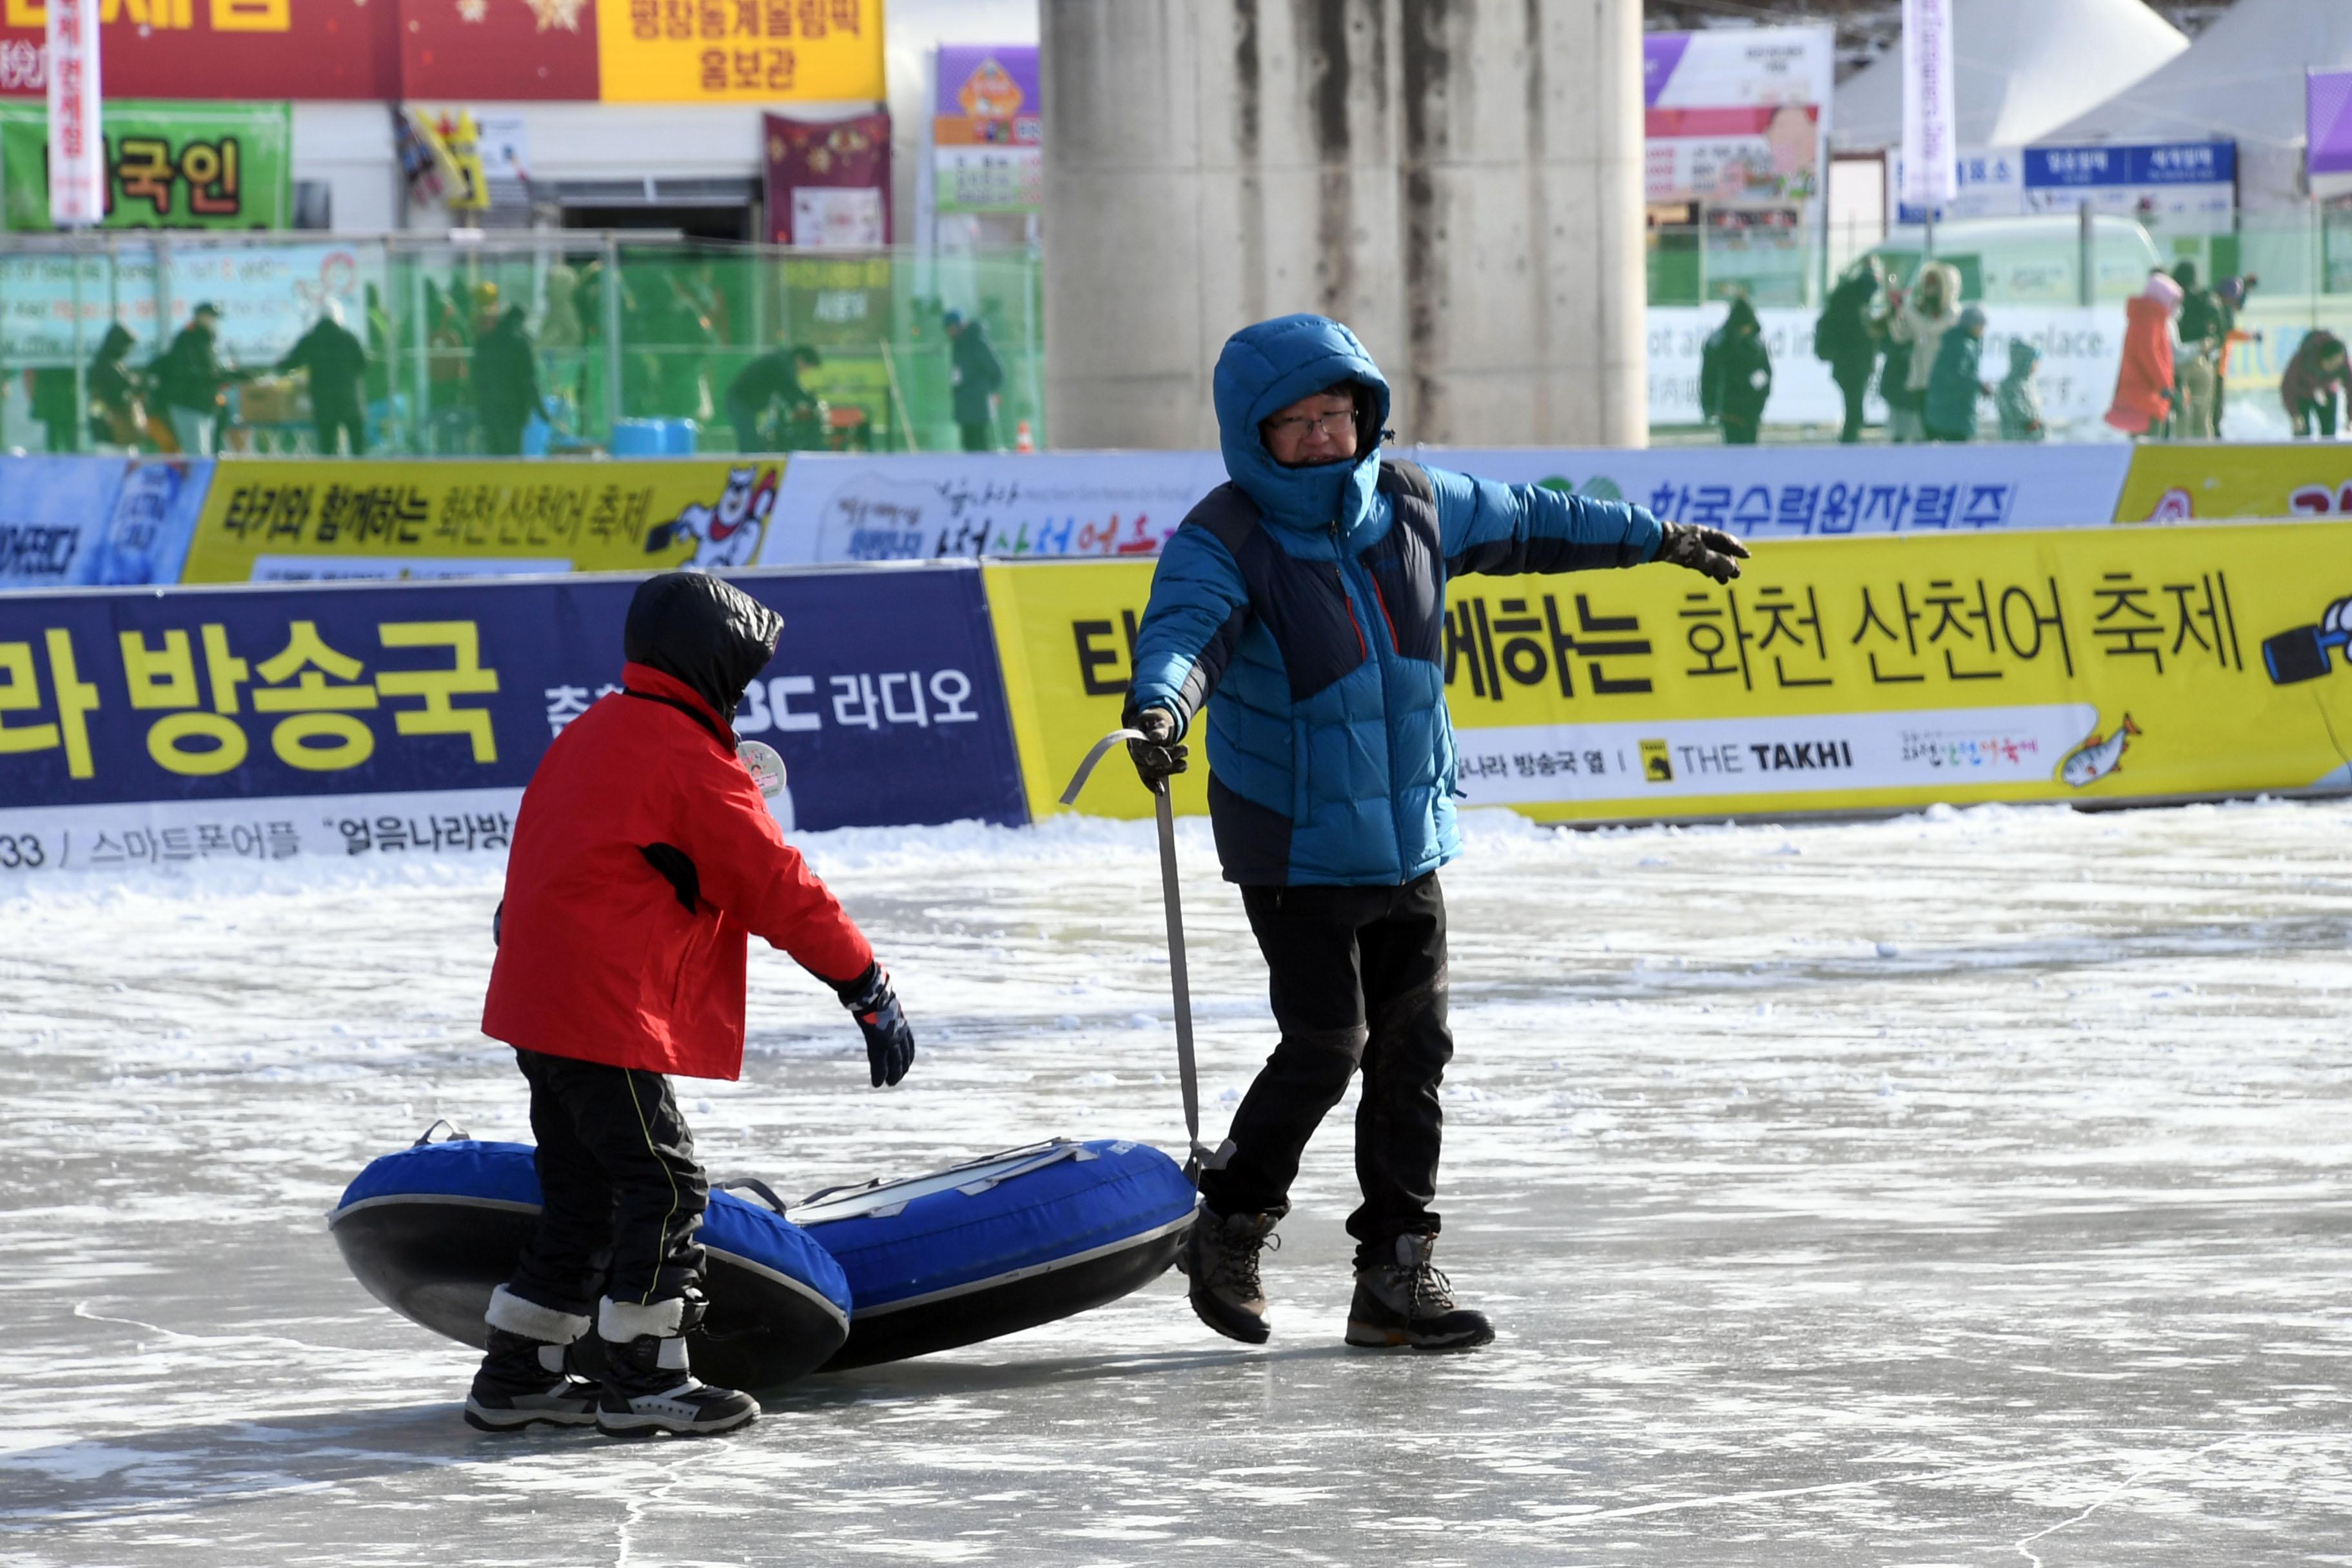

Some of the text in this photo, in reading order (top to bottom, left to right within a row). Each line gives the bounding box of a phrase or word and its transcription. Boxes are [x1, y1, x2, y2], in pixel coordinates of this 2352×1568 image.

[1679, 585, 1834, 691] 화천
[1852, 576, 2073, 683] 산천어
[2093, 571, 2242, 674] 축제
[119, 620, 500, 776] 방송국
[829, 669, 980, 730] 라디오
[1677, 740, 1855, 775] THE TAKHI
